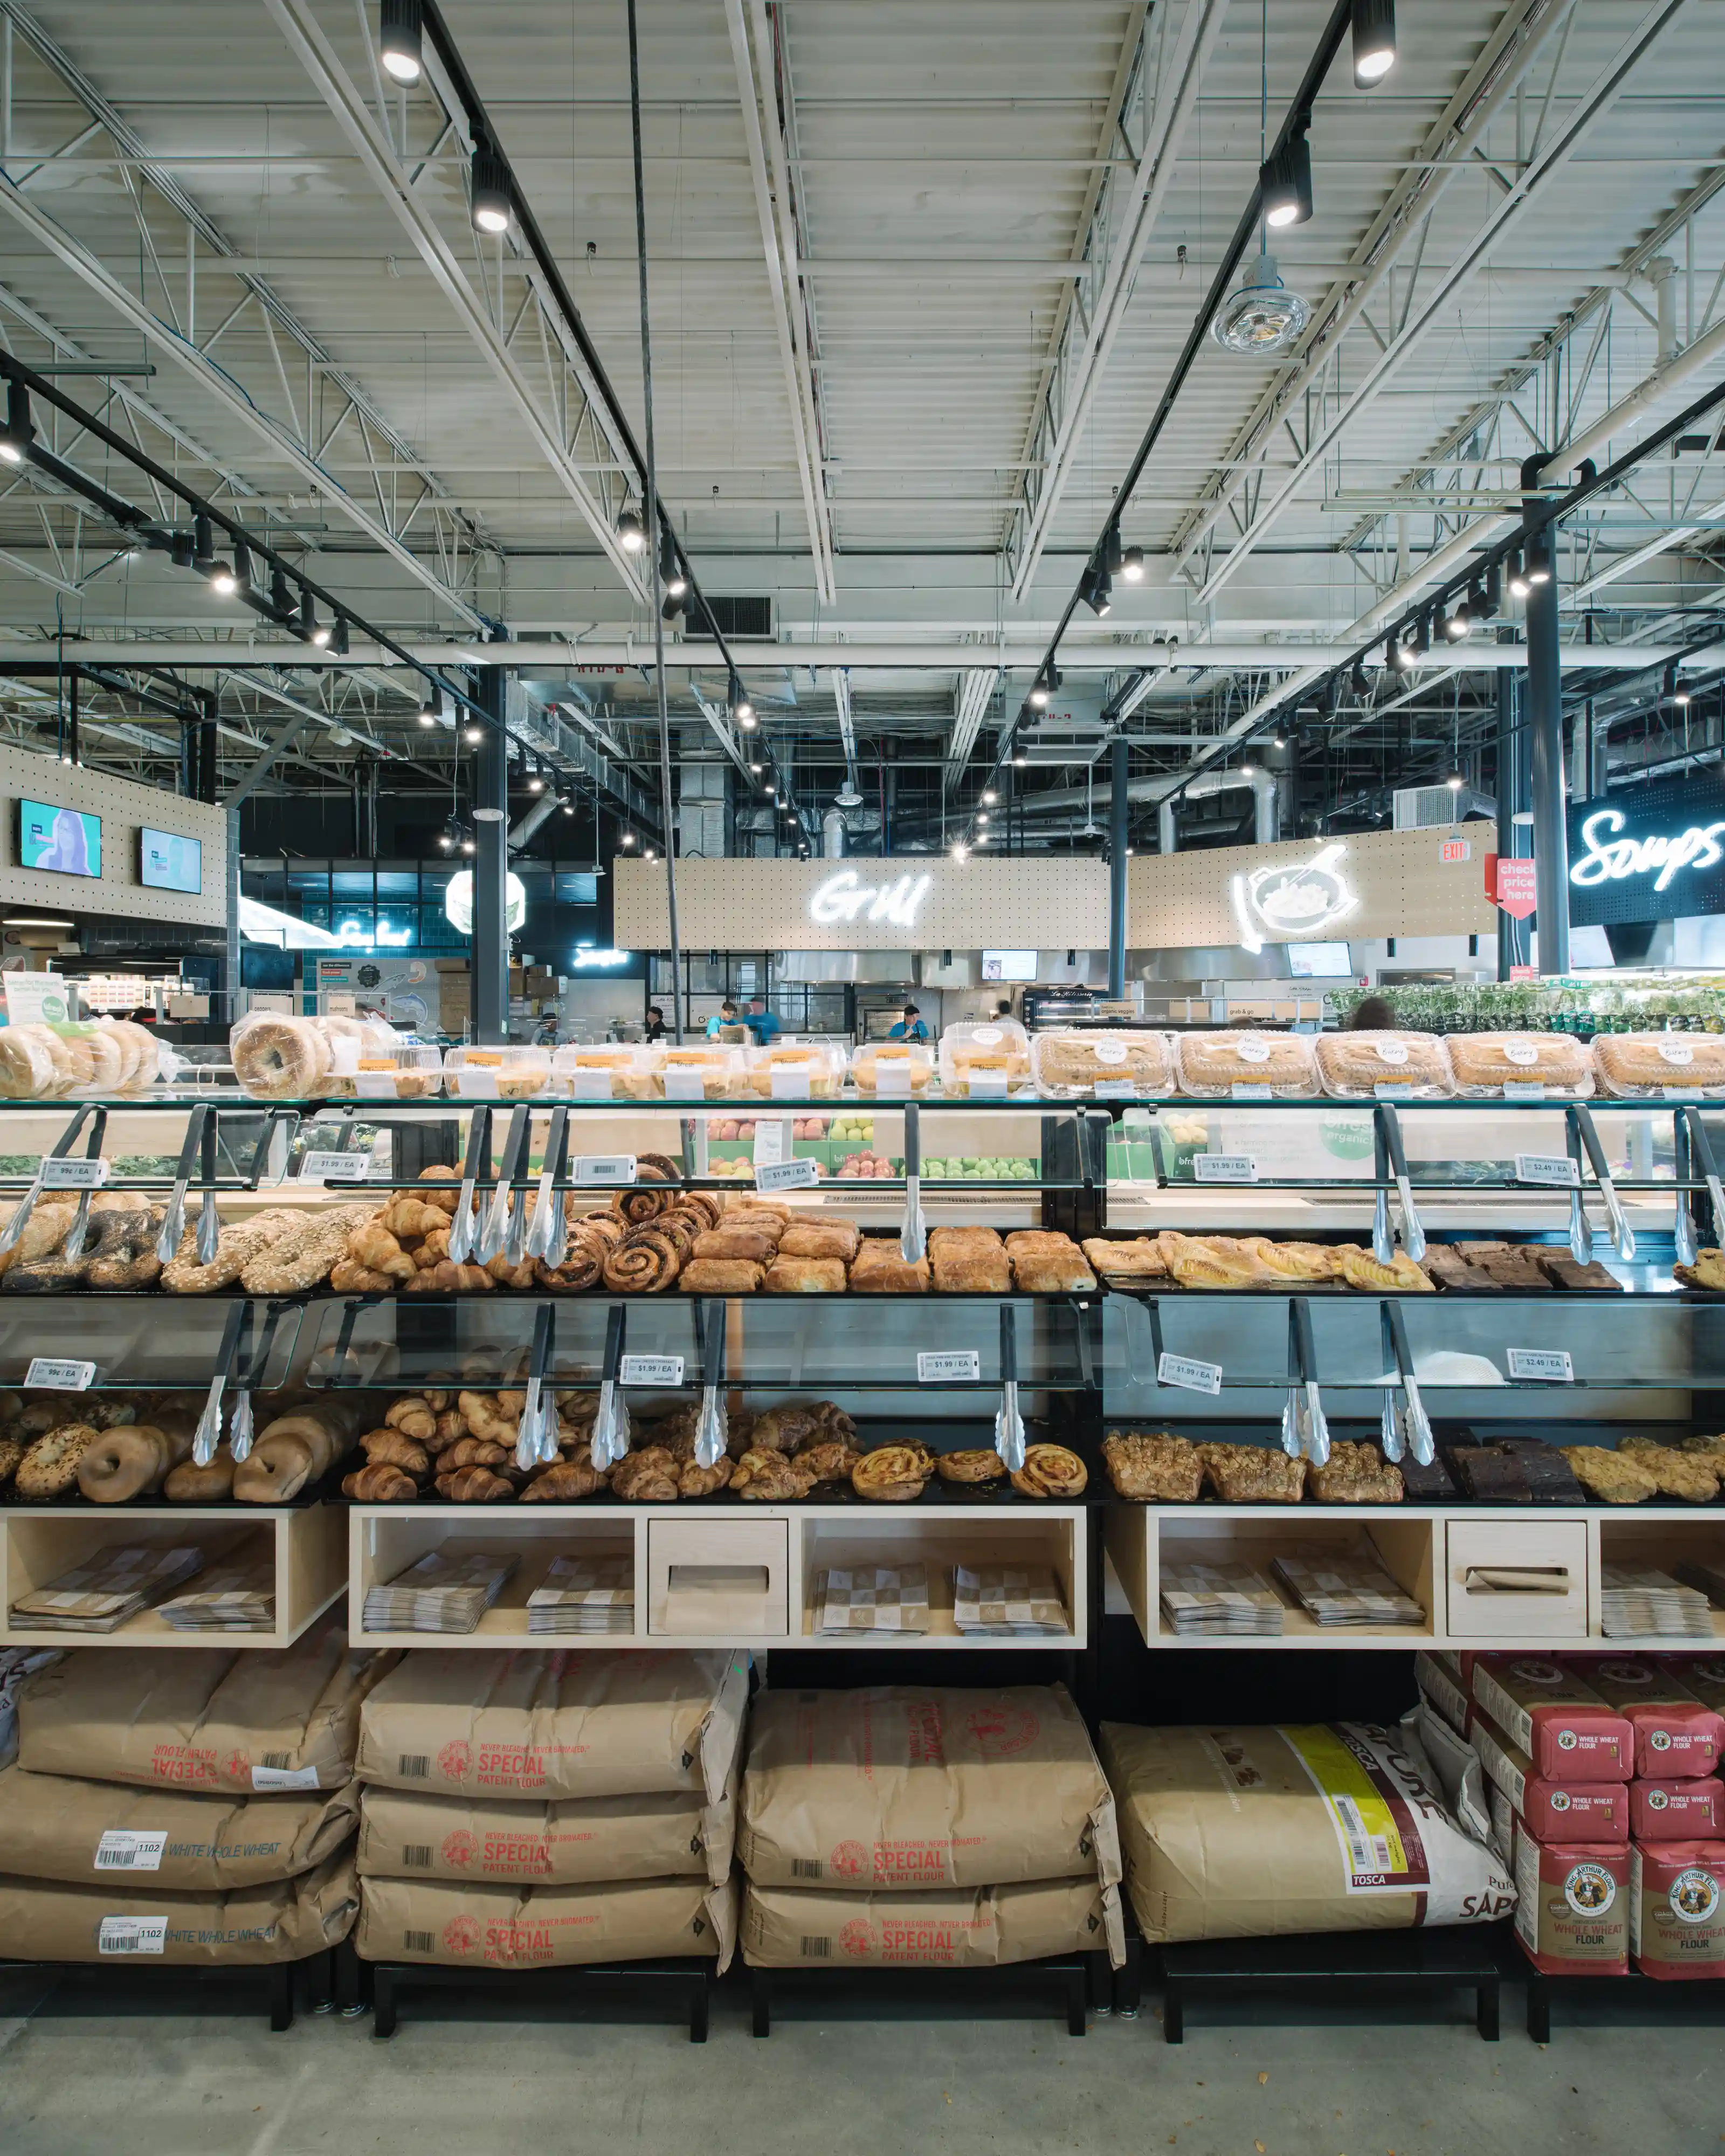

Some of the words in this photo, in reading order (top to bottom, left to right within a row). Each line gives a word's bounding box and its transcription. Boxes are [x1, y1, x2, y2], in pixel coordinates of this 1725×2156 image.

[1444, 842, 1464, 860] EXIT
[1570, 810, 1725, 891] Soups
[1504, 876, 1534, 889] price
[811, 872, 930, 925] Grill
[1507, 889, 1534, 900] here
[1179, 1157, 1195, 1165] bfre
[772, 1170, 791, 1178] $1.99
[1177, 1366, 1195, 1375] $1.99
[154, 1744, 185, 1758] FLOUR
[480, 1743, 500, 1752] NEVER
[151, 1758, 217, 1778] SPECIAL
[478, 1753, 546, 1775] SPECIAL
[477, 1774, 513, 1787] PATENT
[518, 1776, 546, 1789] FLOUR
[485, 1832, 506, 1840] NEVER
[139, 1844, 160, 1852] 1102
[170, 1843, 206, 1857] WHITE
[206, 1844, 242, 1858] WHOLE
[244, 1842, 281, 1856] WHEAT
[928, 1840, 949, 1848] NEVER
[873, 1850, 946, 1870] SPECIAL
[483, 1863, 520, 1874] PATENT
[523, 1864, 554, 1875] FLOUR
[873, 1872, 909, 1883] PATENT
[913, 1871, 944, 1881] FLOUR
[1353, 1875, 1386, 1885] TOSCA
[1565, 1875, 1577, 1891] KING
[1576, 1866, 1603, 1877] ARTHUR
[1601, 1871, 1614, 1891] FLOUR
[1670, 1883, 1681, 1899] KING
[1680, 1871, 1705, 1885] ARTHUR
[1705, 1875, 1718, 1895] FLOUR
[487, 1918, 507, 1926] NEVER
[539, 1918, 559, 1927] NEVER
[882, 1920, 903, 1928] NEVER
[940, 1920, 960, 1929] NEVER
[1554, 1923, 1588, 1934] WHOLE
[1591, 1923, 1624, 1934] WHEAT
[141, 1930, 161, 1938] 1102
[198, 1930, 236, 1944] WHOLE
[237, 1926, 276, 1941] WHEAT
[486, 1928, 554, 1951] SPECIAL
[1576, 1935, 1604, 1945] FLOUR
[1658, 1928, 1694, 1940] WHOLE
[882, 1931, 955, 1951] SPECIAL
[1680, 1940, 1709, 1949] FLOUR
[484, 1950, 519, 1961] PATENT
[523, 1950, 554, 1961] FLOUR
[882, 1952, 919, 1961] PATENT
[923, 1951, 954, 1961] FLOUR
